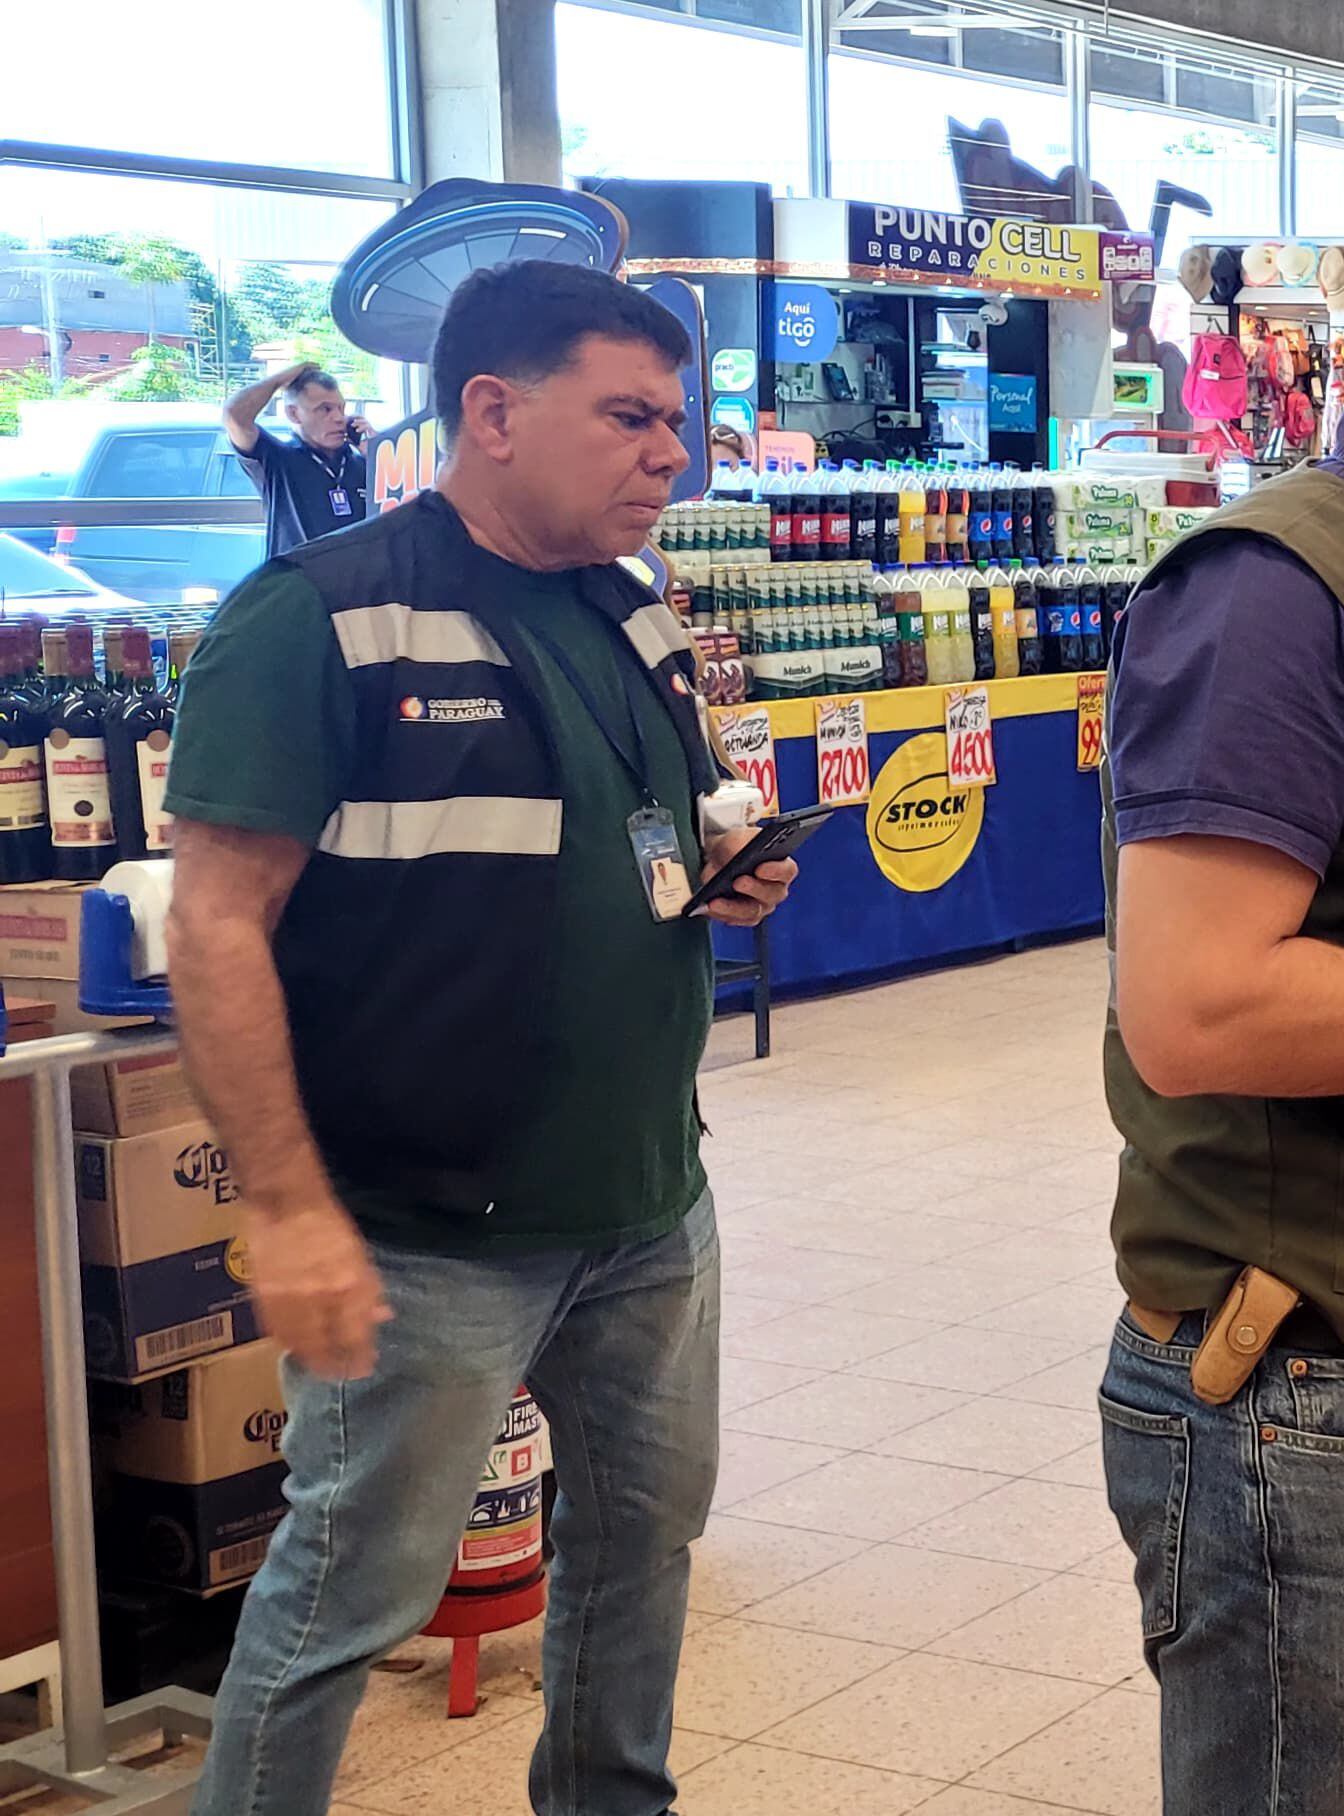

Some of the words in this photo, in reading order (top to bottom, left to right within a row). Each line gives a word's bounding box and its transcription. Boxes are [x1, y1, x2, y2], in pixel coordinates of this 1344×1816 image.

[873, 206, 992, 250] PUNTO
[1000, 222, 1082, 263] CELL
[868, 240, 1086, 282] REPARACIONES
[784, 301, 811, 316] Aquí
[778, 318, 816, 347] tigo
[428, 705, 504, 719] PARAGUAY
[951, 729, 993, 777] 4500
[821, 745, 867, 800] 2700
[885, 794, 968, 824] STOCK
[516, 1452, 529, 1472] B
